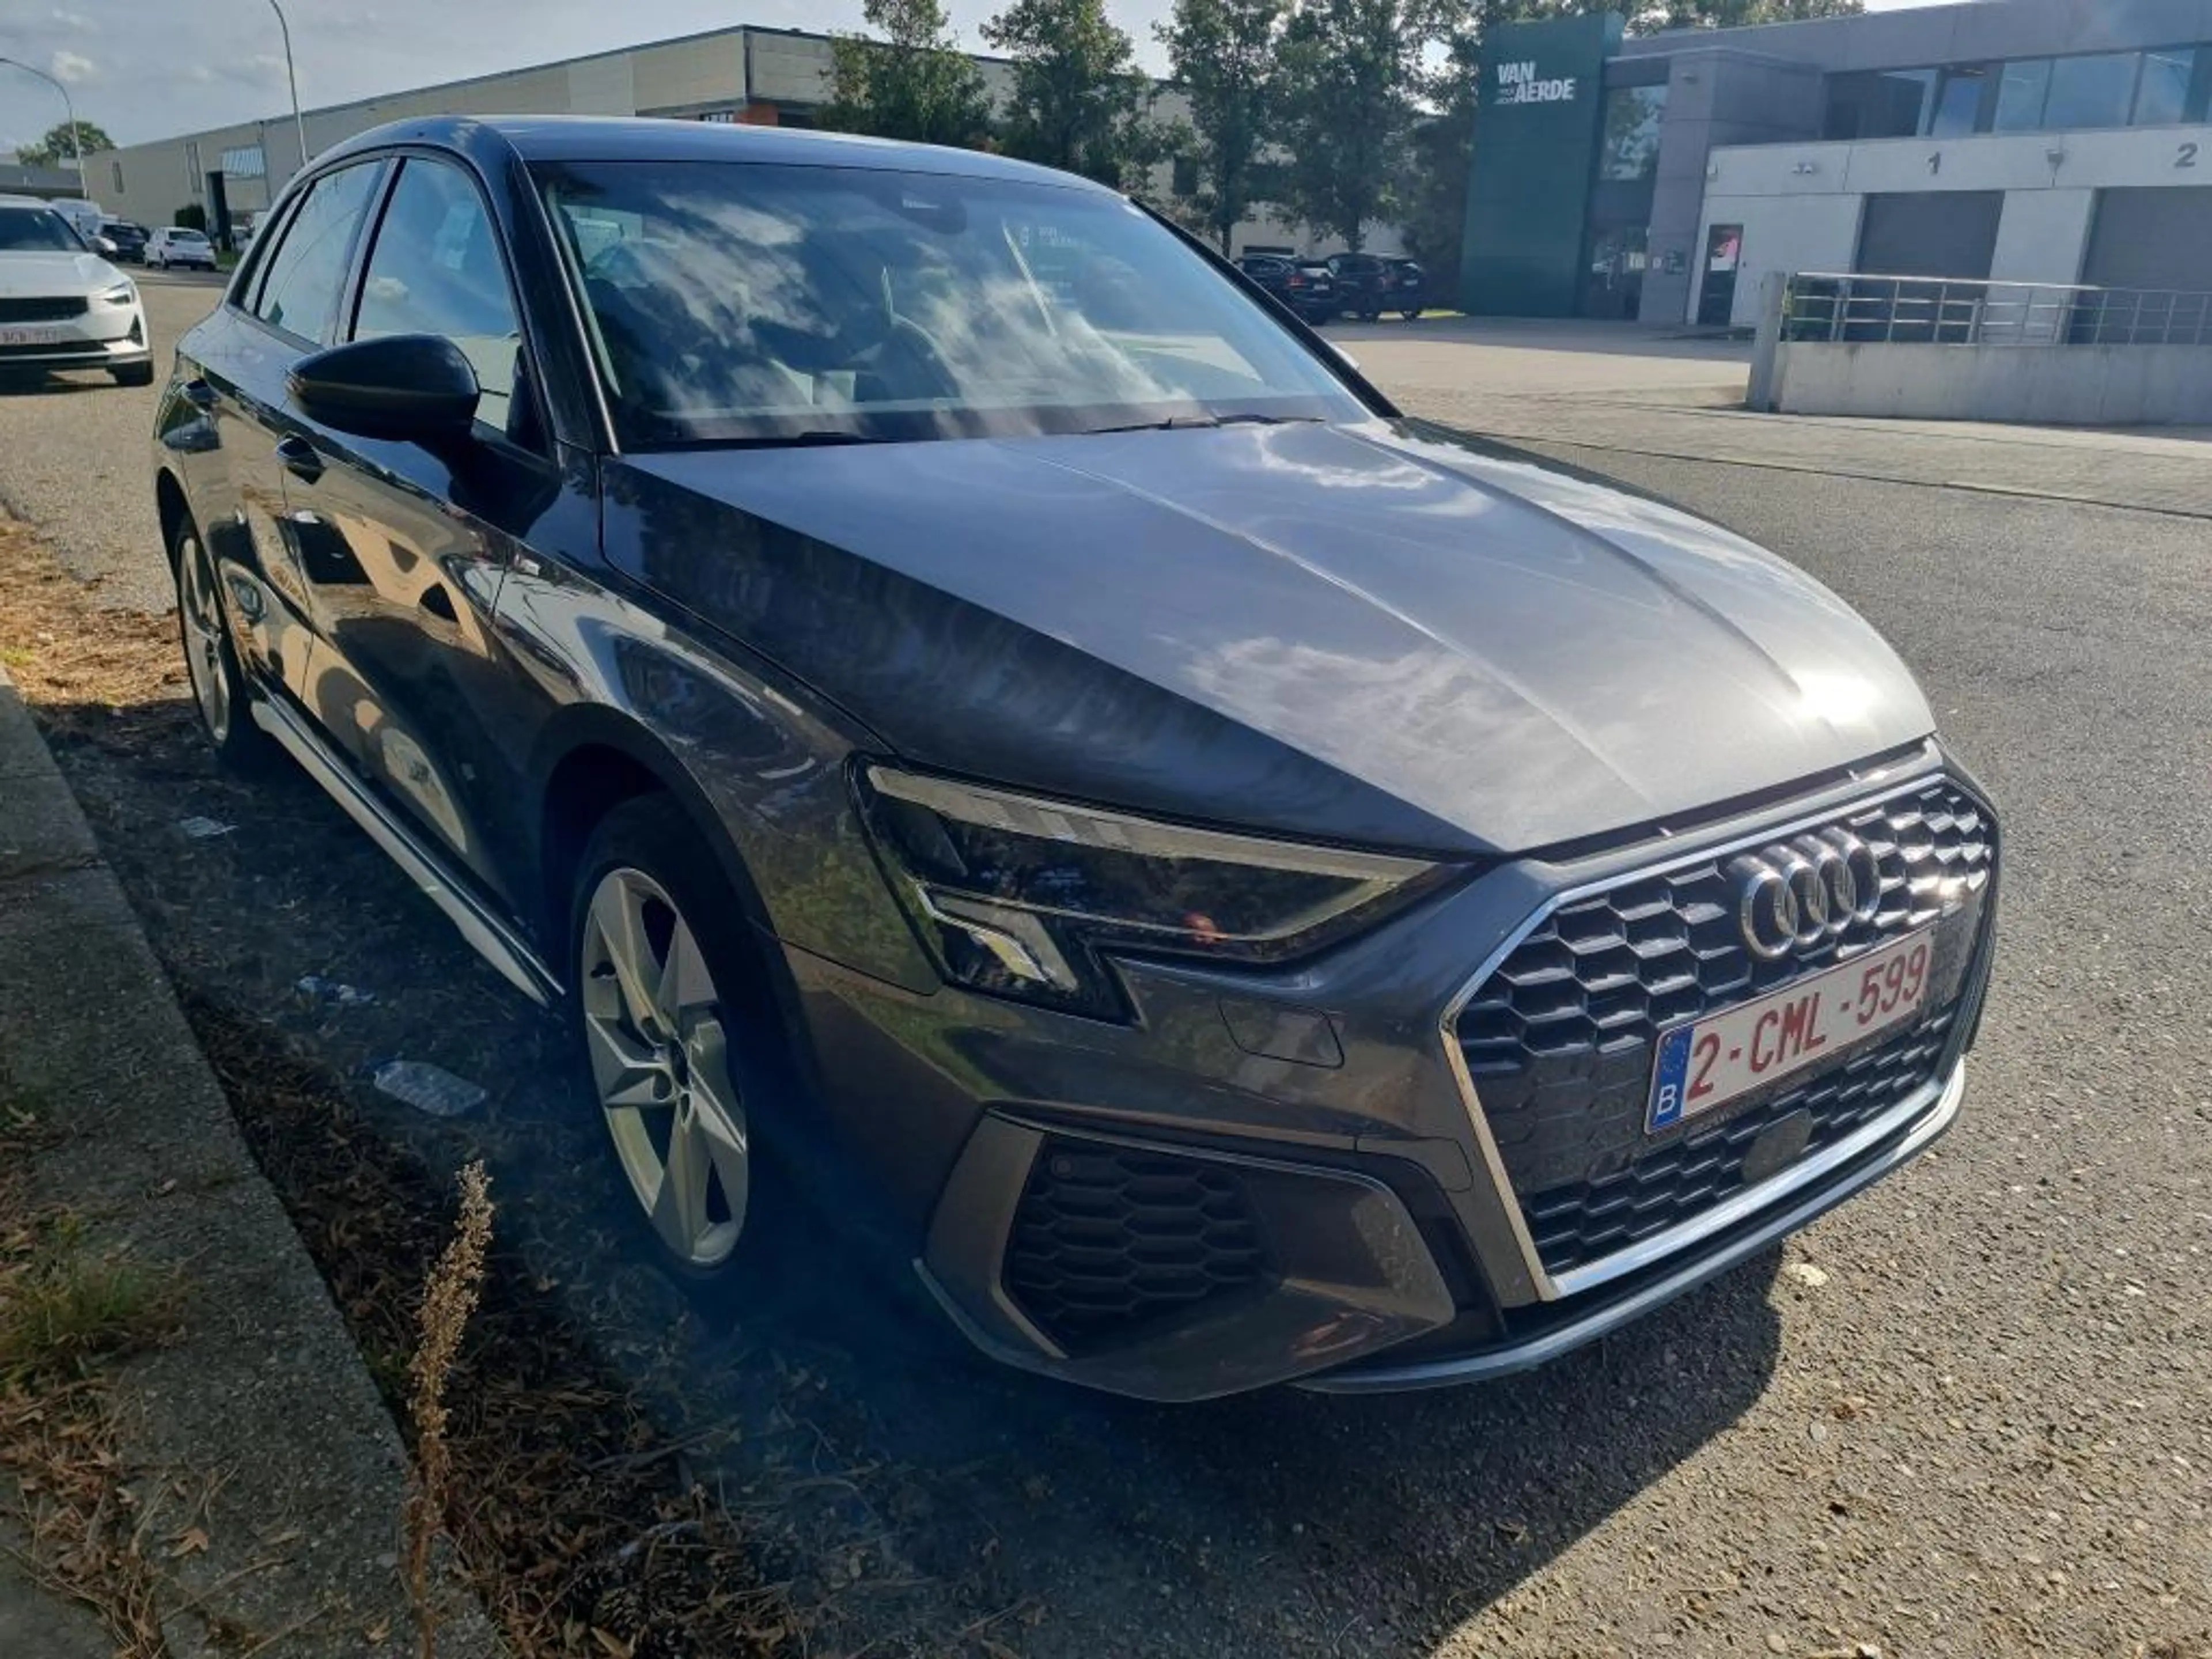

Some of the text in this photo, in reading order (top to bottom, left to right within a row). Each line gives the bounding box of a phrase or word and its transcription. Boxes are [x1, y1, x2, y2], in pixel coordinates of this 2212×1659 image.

[1498, 61, 1536, 84] VAN
[1514, 78, 1576, 103] AERDE
[1929, 151, 1941, 175] 1
[2174, 142, 2198, 168] 2
[1657, 1084, 1677, 1115] B
